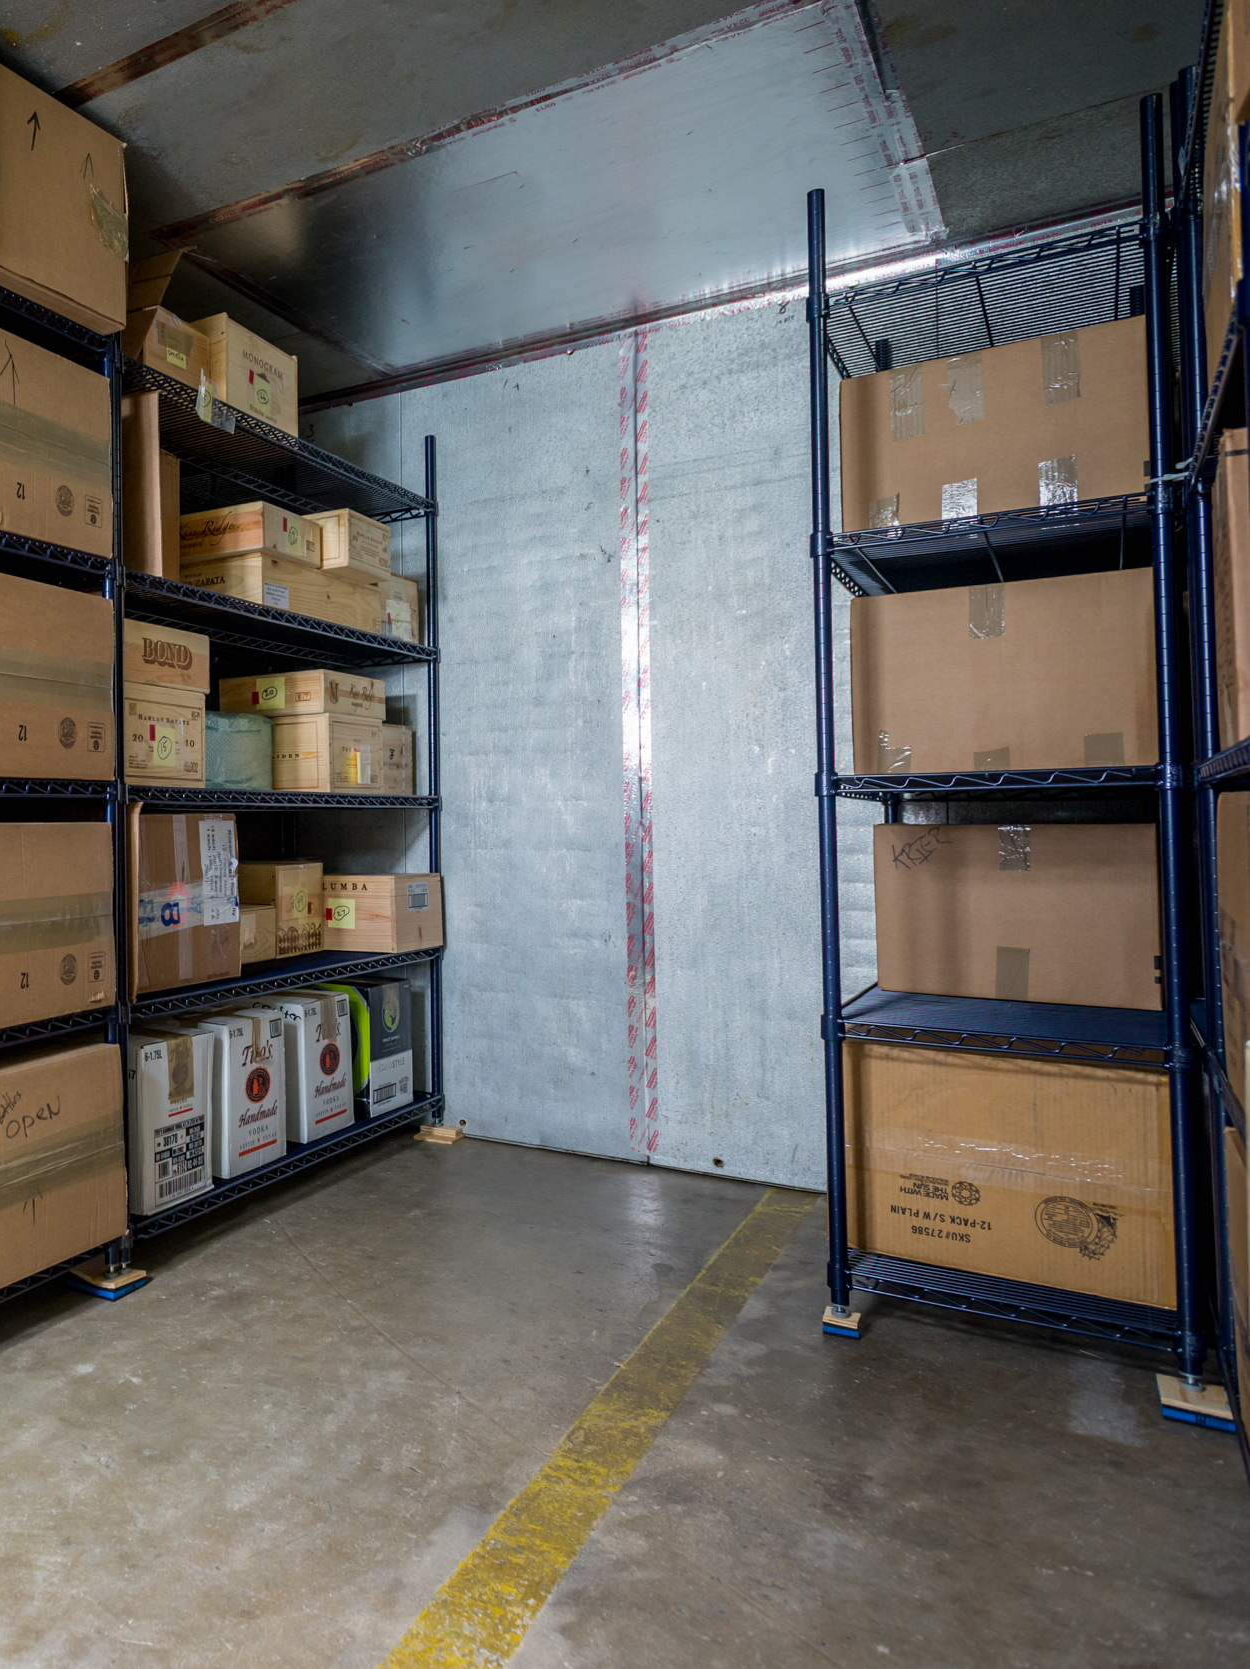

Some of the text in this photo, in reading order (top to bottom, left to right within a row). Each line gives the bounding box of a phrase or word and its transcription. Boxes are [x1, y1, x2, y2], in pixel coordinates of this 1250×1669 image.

[242, 348, 283, 380] MONOGRAM
[16, 481, 26, 501] 12
[202, 511, 237, 546] Ridge
[142, 637, 193, 671] BOND
[138, 713, 164, 724] HARLAN
[18, 724, 28, 742] 12
[132, 733, 144, 743] 20
[184, 739, 195, 748] 10
[20, 972, 30, 990] 12
[144, 1049, 163, 1062] 6-1.75L
[314, 1073, 347, 1098] Handmade
[238, 1099, 278, 1128] Handmade
[248, 1124, 269, 1136] VODKA
[899, 1186, 949, 1201] MADE WITH
[913, 1182, 948, 1195] THE SUN
[890, 1204, 919, 1218] PLAIN
[949, 1214, 992, 1231] 12-PACK
[911, 1225, 971, 1243] SKU# 27586
